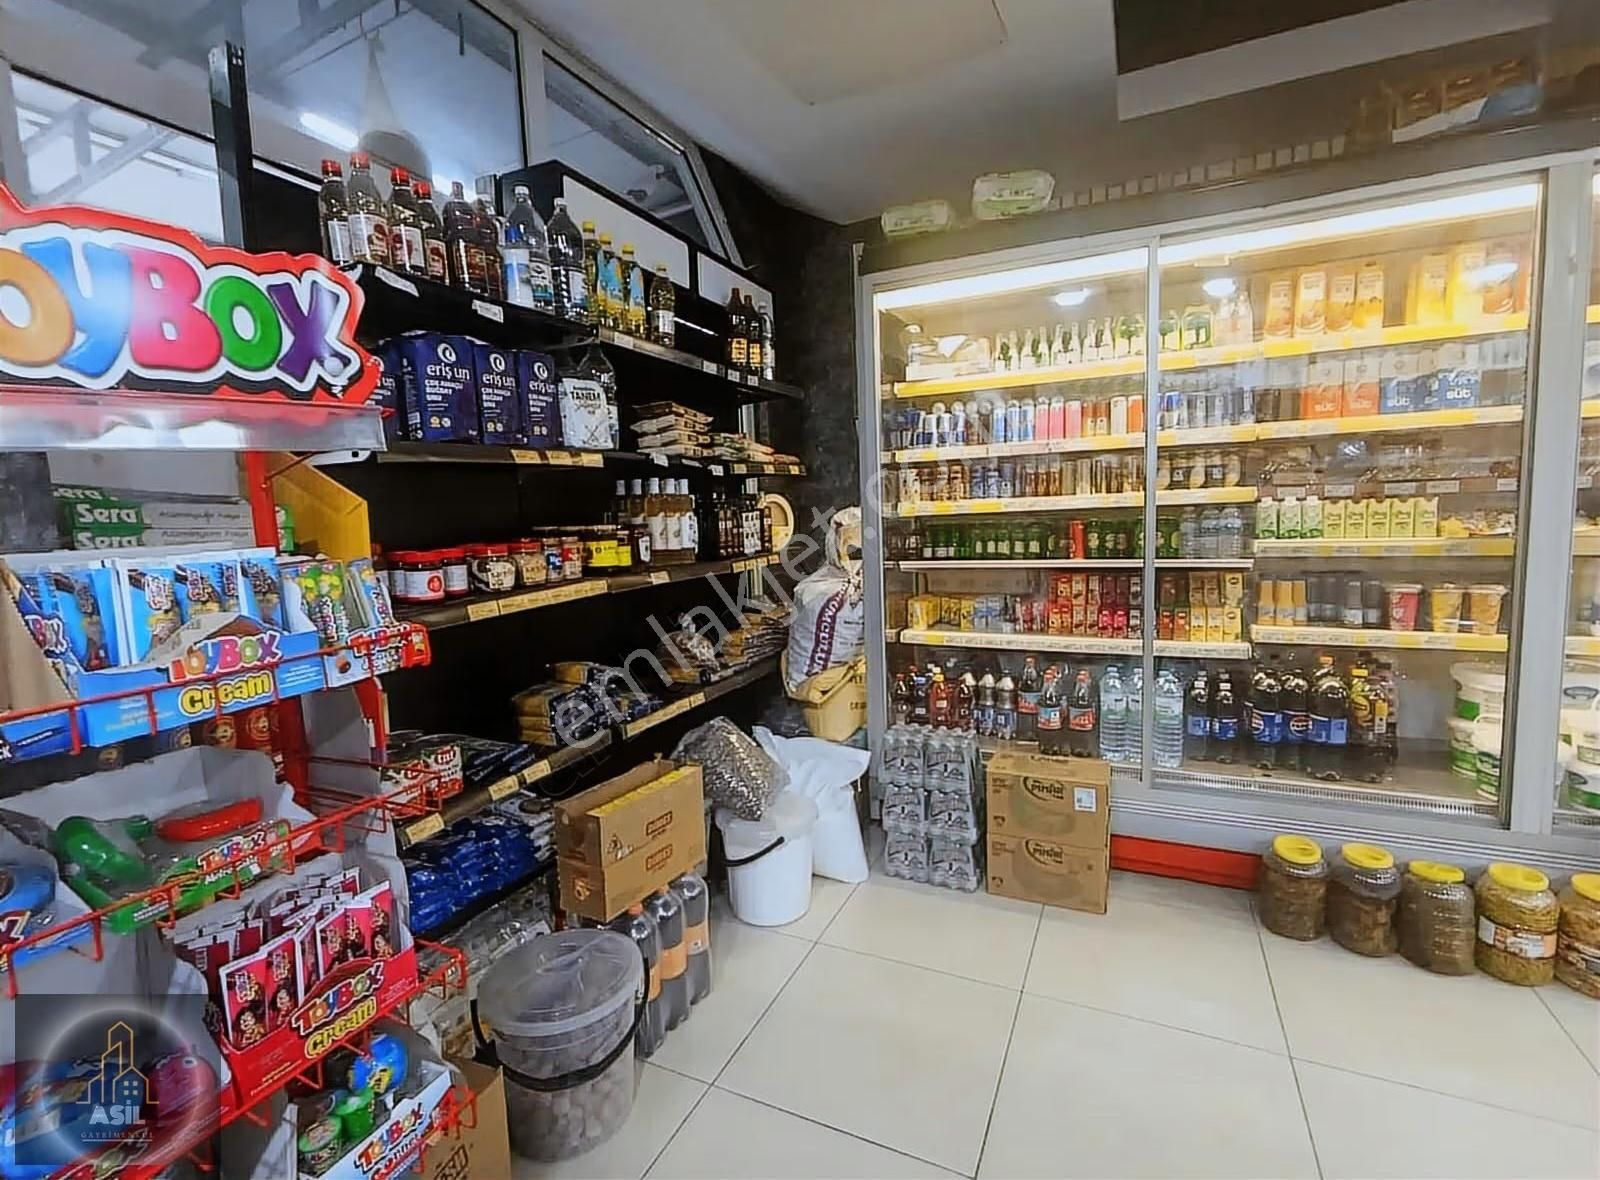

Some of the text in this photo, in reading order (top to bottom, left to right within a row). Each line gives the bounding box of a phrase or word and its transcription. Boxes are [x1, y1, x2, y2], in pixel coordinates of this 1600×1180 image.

[0, 237, 348, 378] OYBOX
[76, 503, 138, 523] Sera
[76, 531, 138, 549] Sera
[181, 672, 272, 715] Cream
